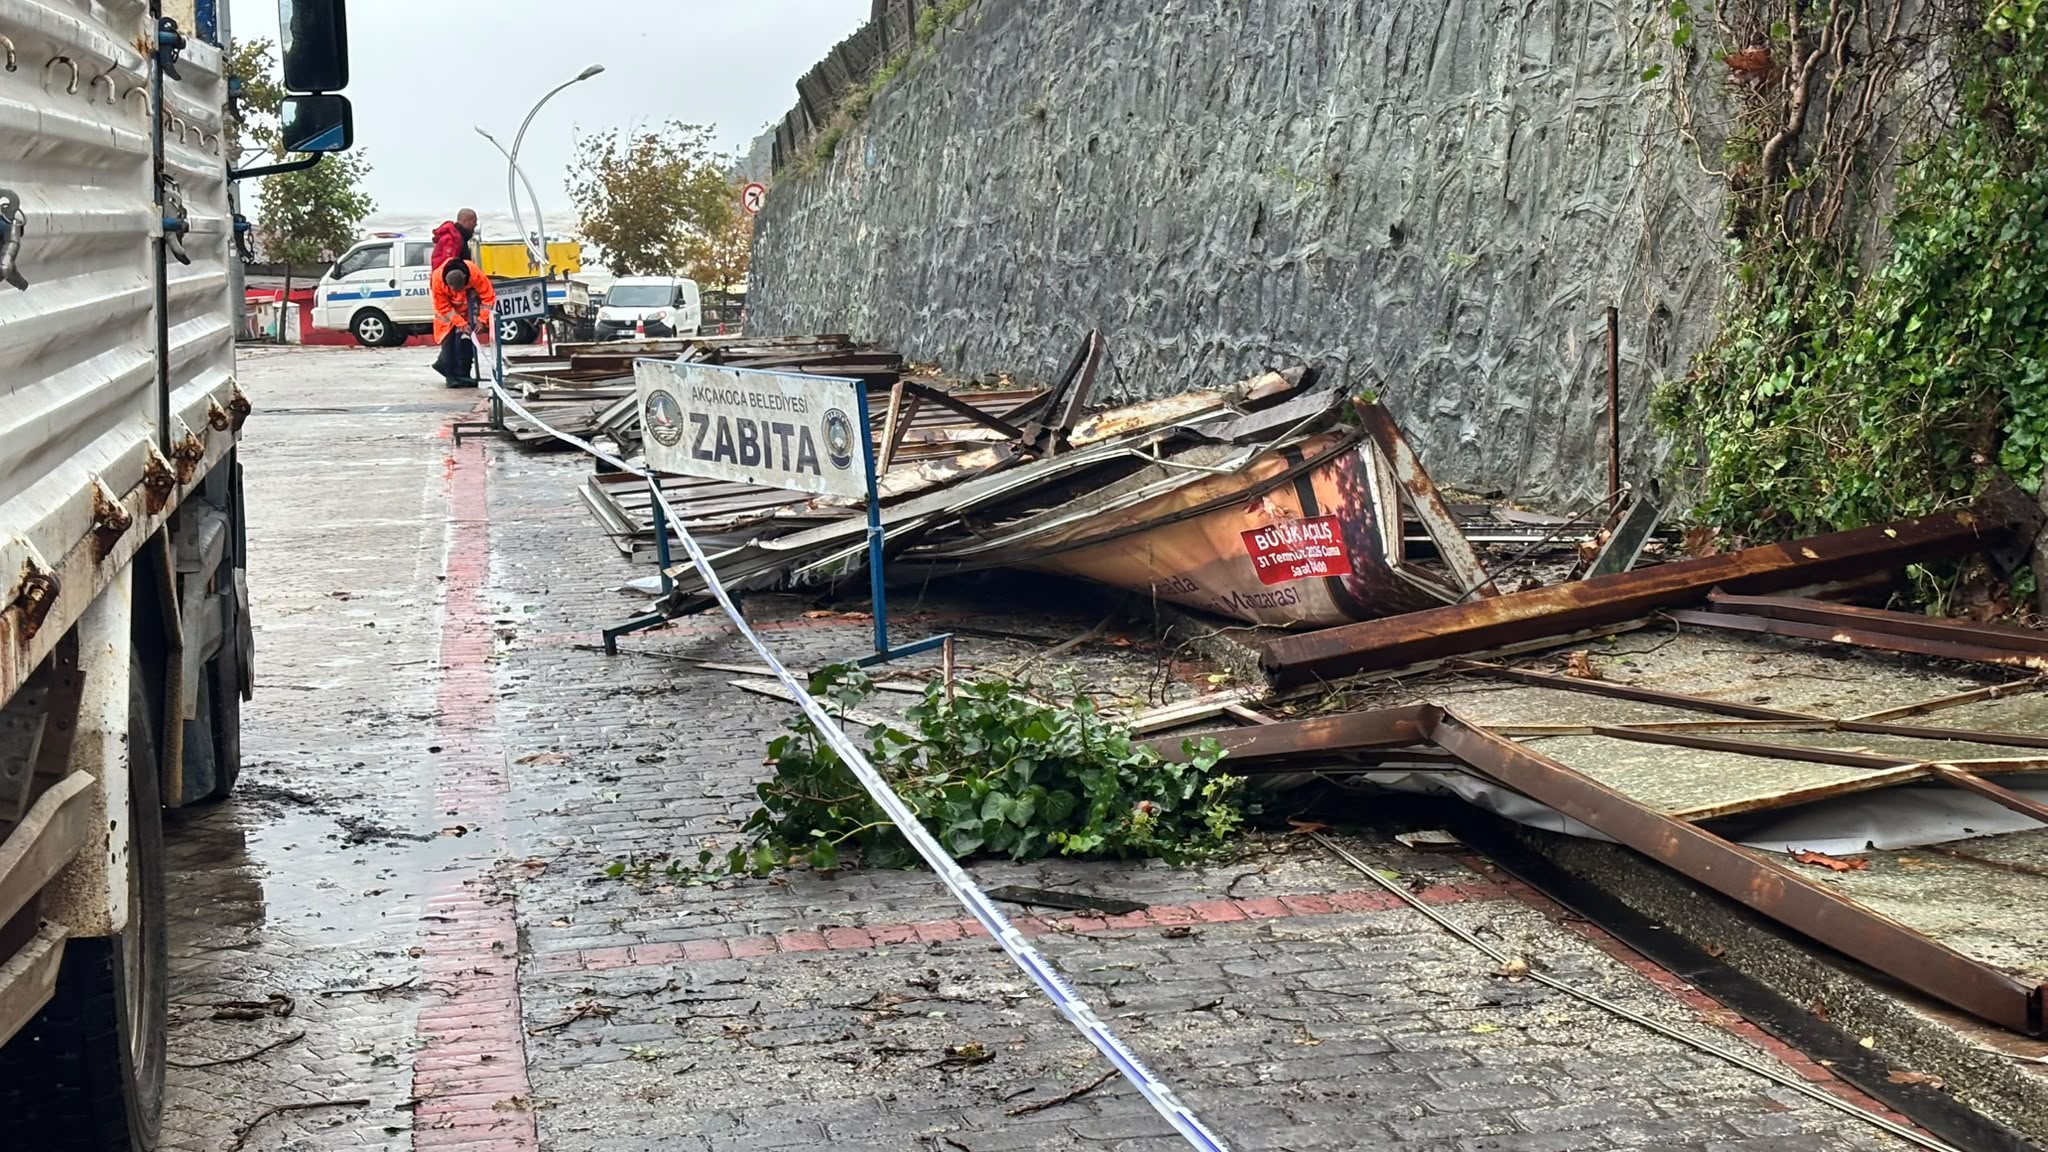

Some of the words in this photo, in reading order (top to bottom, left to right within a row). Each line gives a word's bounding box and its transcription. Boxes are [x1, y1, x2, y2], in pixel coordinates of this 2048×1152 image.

[404, 287, 430, 297] ZABI
[495, 296, 531, 316] ABITA
[691, 386, 748, 407] AKÇAKOCA
[749, 391, 809, 414] BELEDİYESİ
[689, 412, 822, 476] ZABITA
[1254, 525, 1303, 551] BÜYÜK
[1303, 521, 1333, 545] AÇILIŞ
[1257, 556, 1270, 569] 31
[1291, 562, 1311, 578] Saat
